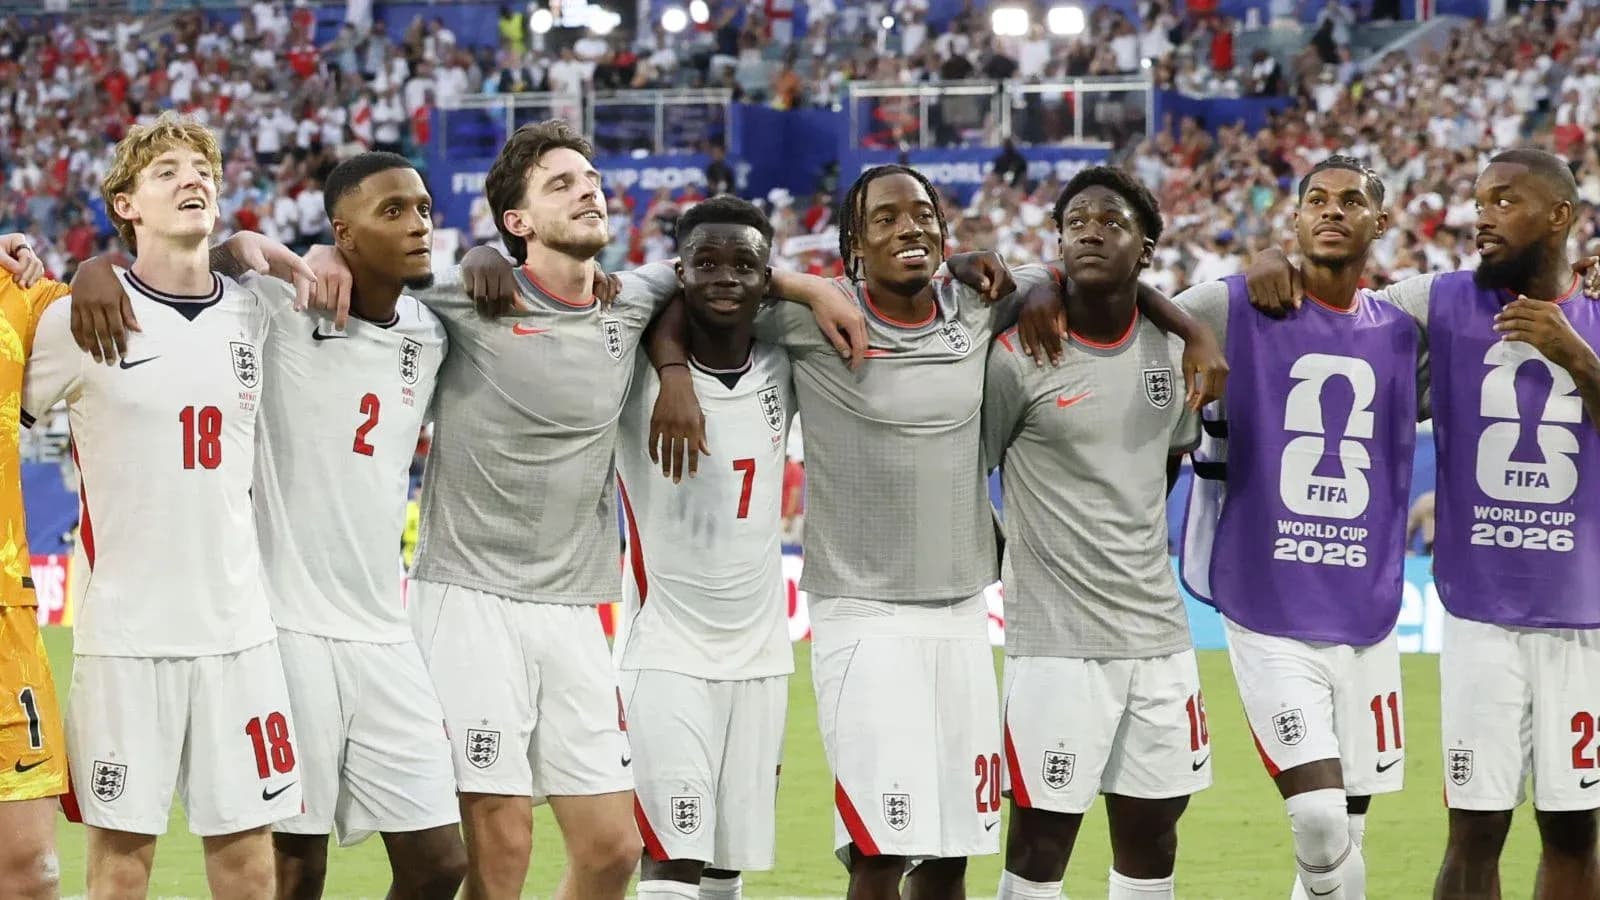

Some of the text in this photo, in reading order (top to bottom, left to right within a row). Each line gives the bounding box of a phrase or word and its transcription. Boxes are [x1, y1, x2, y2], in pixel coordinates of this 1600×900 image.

[640, 167, 708, 190] 202
[179, 405, 222, 469] 18
[353, 393, 380, 456] 2
[733, 458, 755, 518] 7
[1307, 484, 1348, 504] FIFA
[1504, 470, 1550, 488] FIFA
[1278, 519, 1368, 541] WORLD CUP
[1471, 523, 1574, 552] 2026
[1474, 505, 1576, 526] WORLD CUP
[1273, 538, 1367, 568] 2026
[19, 686, 42, 749] 1
[246, 711, 296, 779] 18
[1370, 691, 1402, 752] 11
[1571, 711, 1600, 769] 2
[975, 753, 1001, 813] 20
